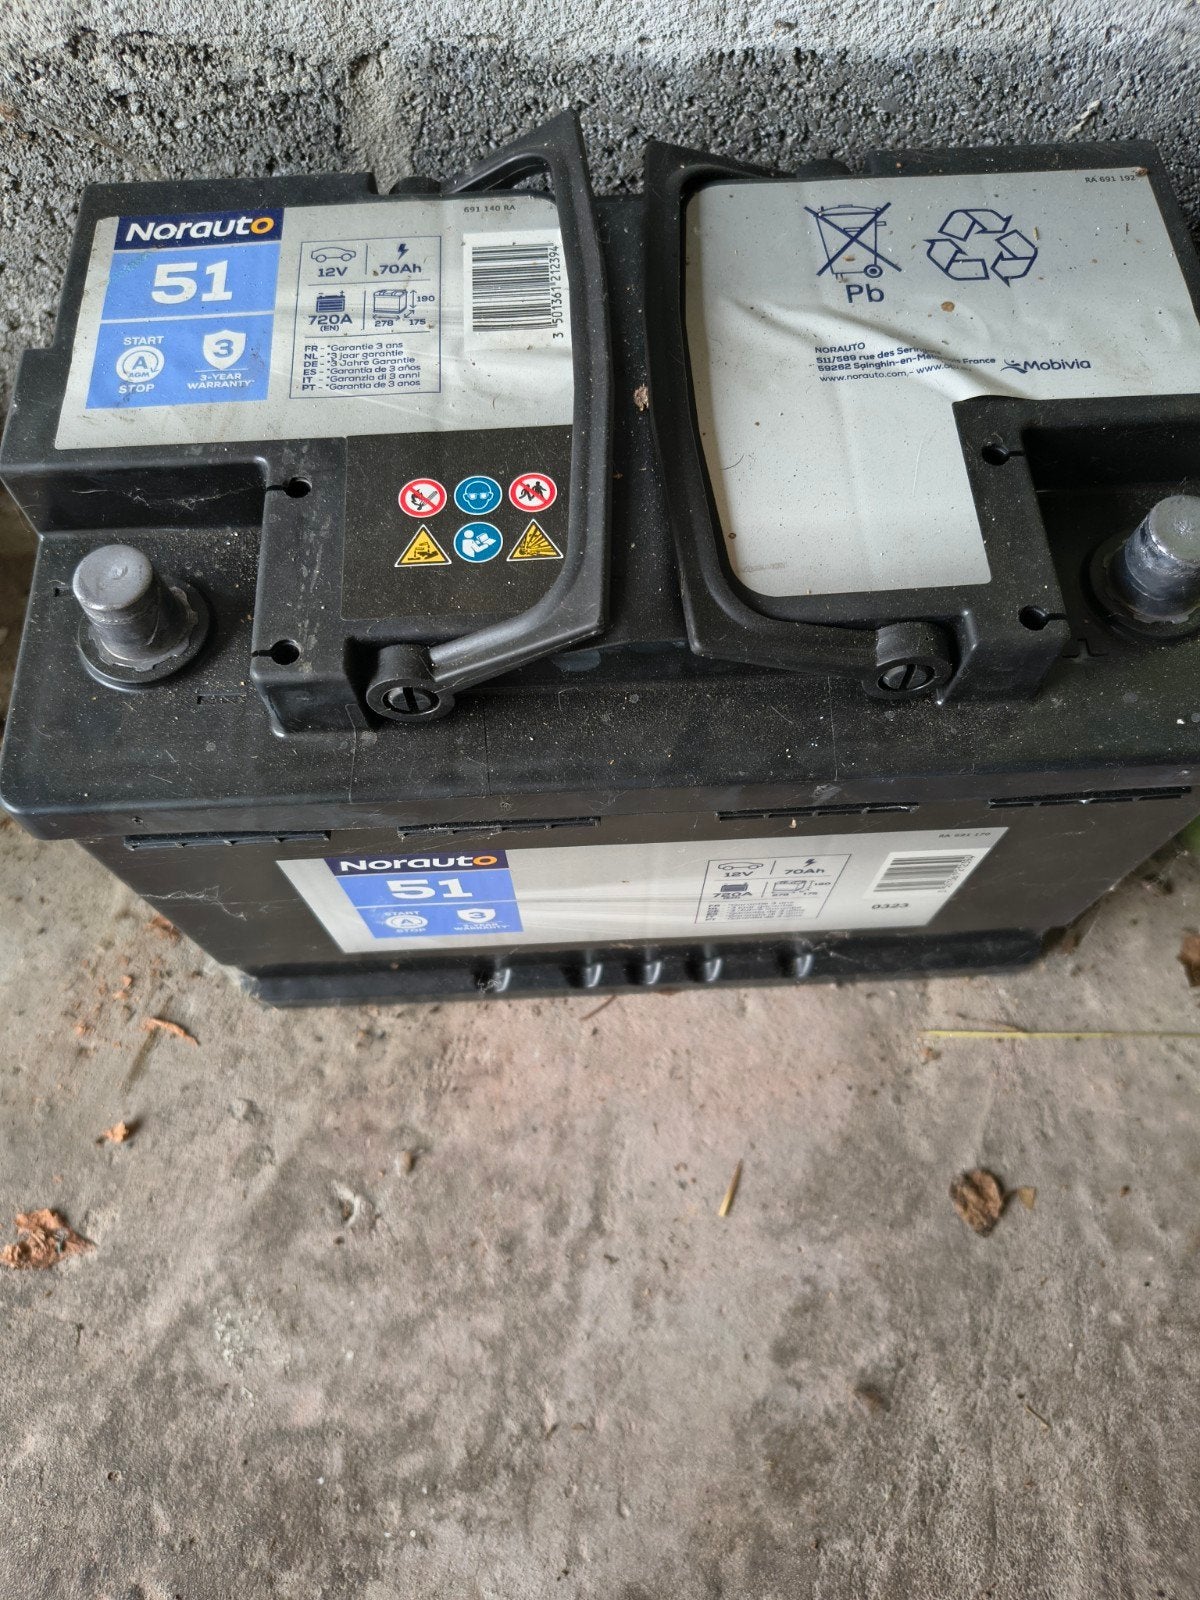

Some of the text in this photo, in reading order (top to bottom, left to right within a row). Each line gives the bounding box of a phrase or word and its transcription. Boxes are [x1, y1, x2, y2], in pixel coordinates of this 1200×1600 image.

[126, 216, 274, 242] Norauto
[380, 264, 422, 274] 70Ah
[549, 246, 561, 282] 212394
[318, 266, 348, 277] 12V
[151, 260, 233, 304] 51
[845, 283, 884, 304] Pb
[551, 286, 563, 323] 501361
[308, 314, 352, 325] 720A
[409, 318, 426, 326] 175
[320, 324, 340, 332] (EN)
[123, 336, 164, 346] START
[376, 342, 383, 350] 3
[214, 338, 234, 358] 3
[815, 342, 866, 353] NORAUTO
[340, 351, 360, 360] jaar
[362, 350, 404, 359] garantie
[877, 350, 894, 358] des
[132, 356, 148, 370] A
[372, 357, 416, 365] Garantie
[1024, 358, 1091, 371] Mobivia
[398, 363, 421, 371] años
[200, 372, 241, 381] 3-YEAR
[118, 383, 154, 394] STOP
[340, 855, 498, 872] Norauto
[386, 878, 473, 900] 51
[872, 902, 910, 910] 0323
